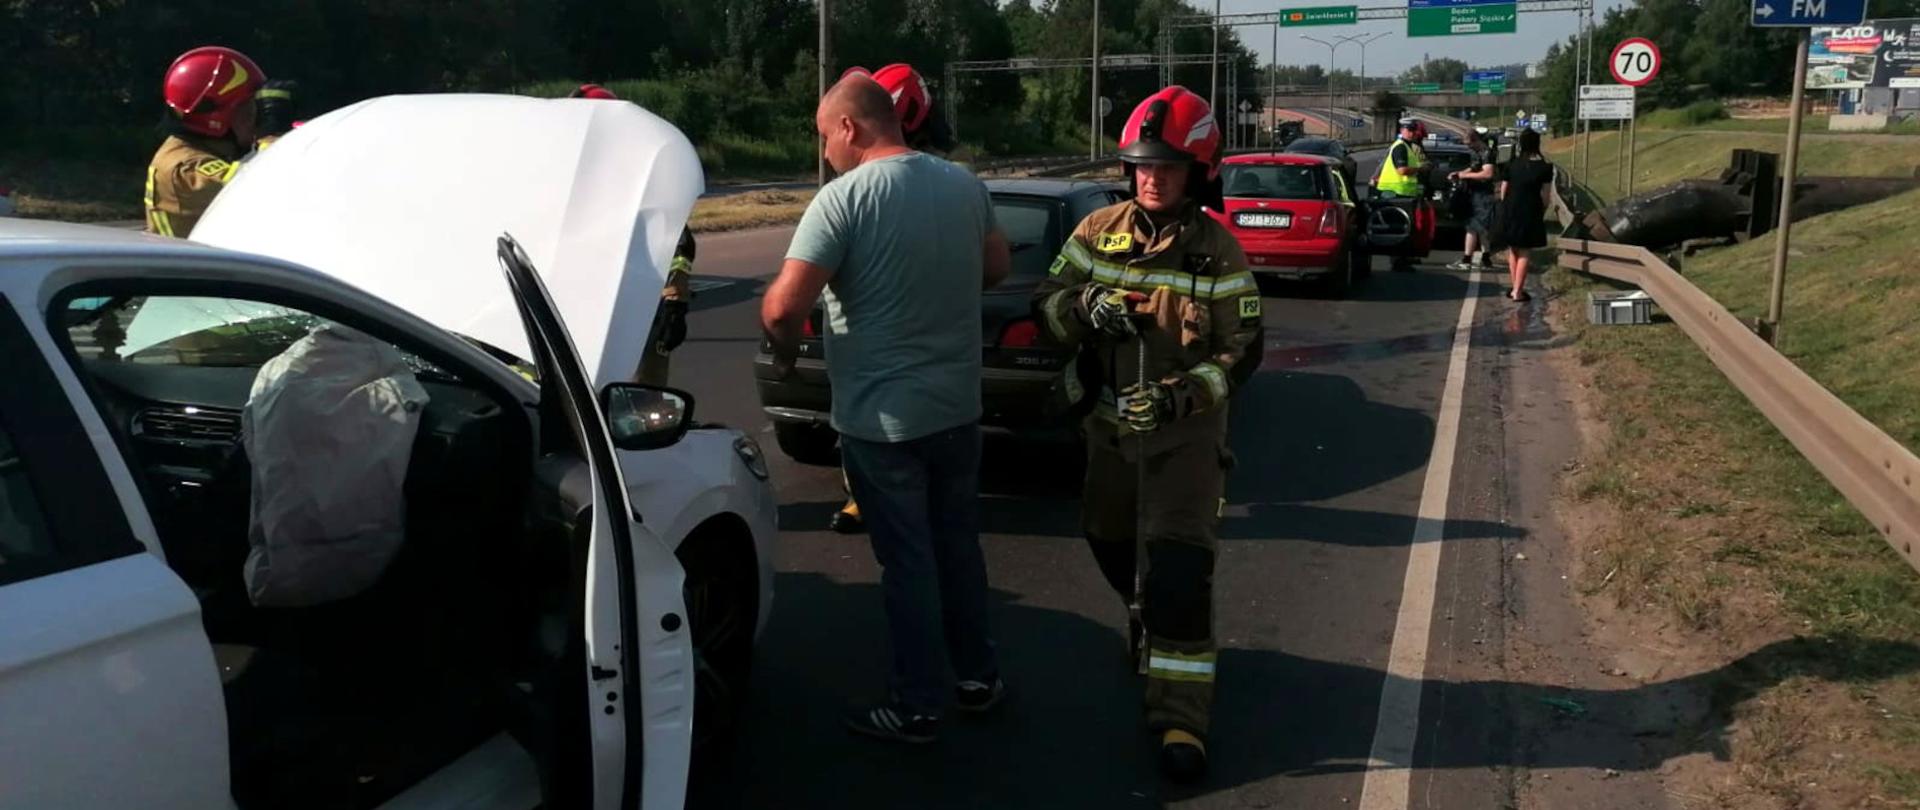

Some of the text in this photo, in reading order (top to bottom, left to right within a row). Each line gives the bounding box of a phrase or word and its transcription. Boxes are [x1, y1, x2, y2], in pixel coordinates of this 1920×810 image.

[1791, 0, 1826, 18] FM
[1830, 26, 1874, 40] LATO
[1620, 51, 1652, 74] 70
[1103, 235, 1127, 248] PSP
